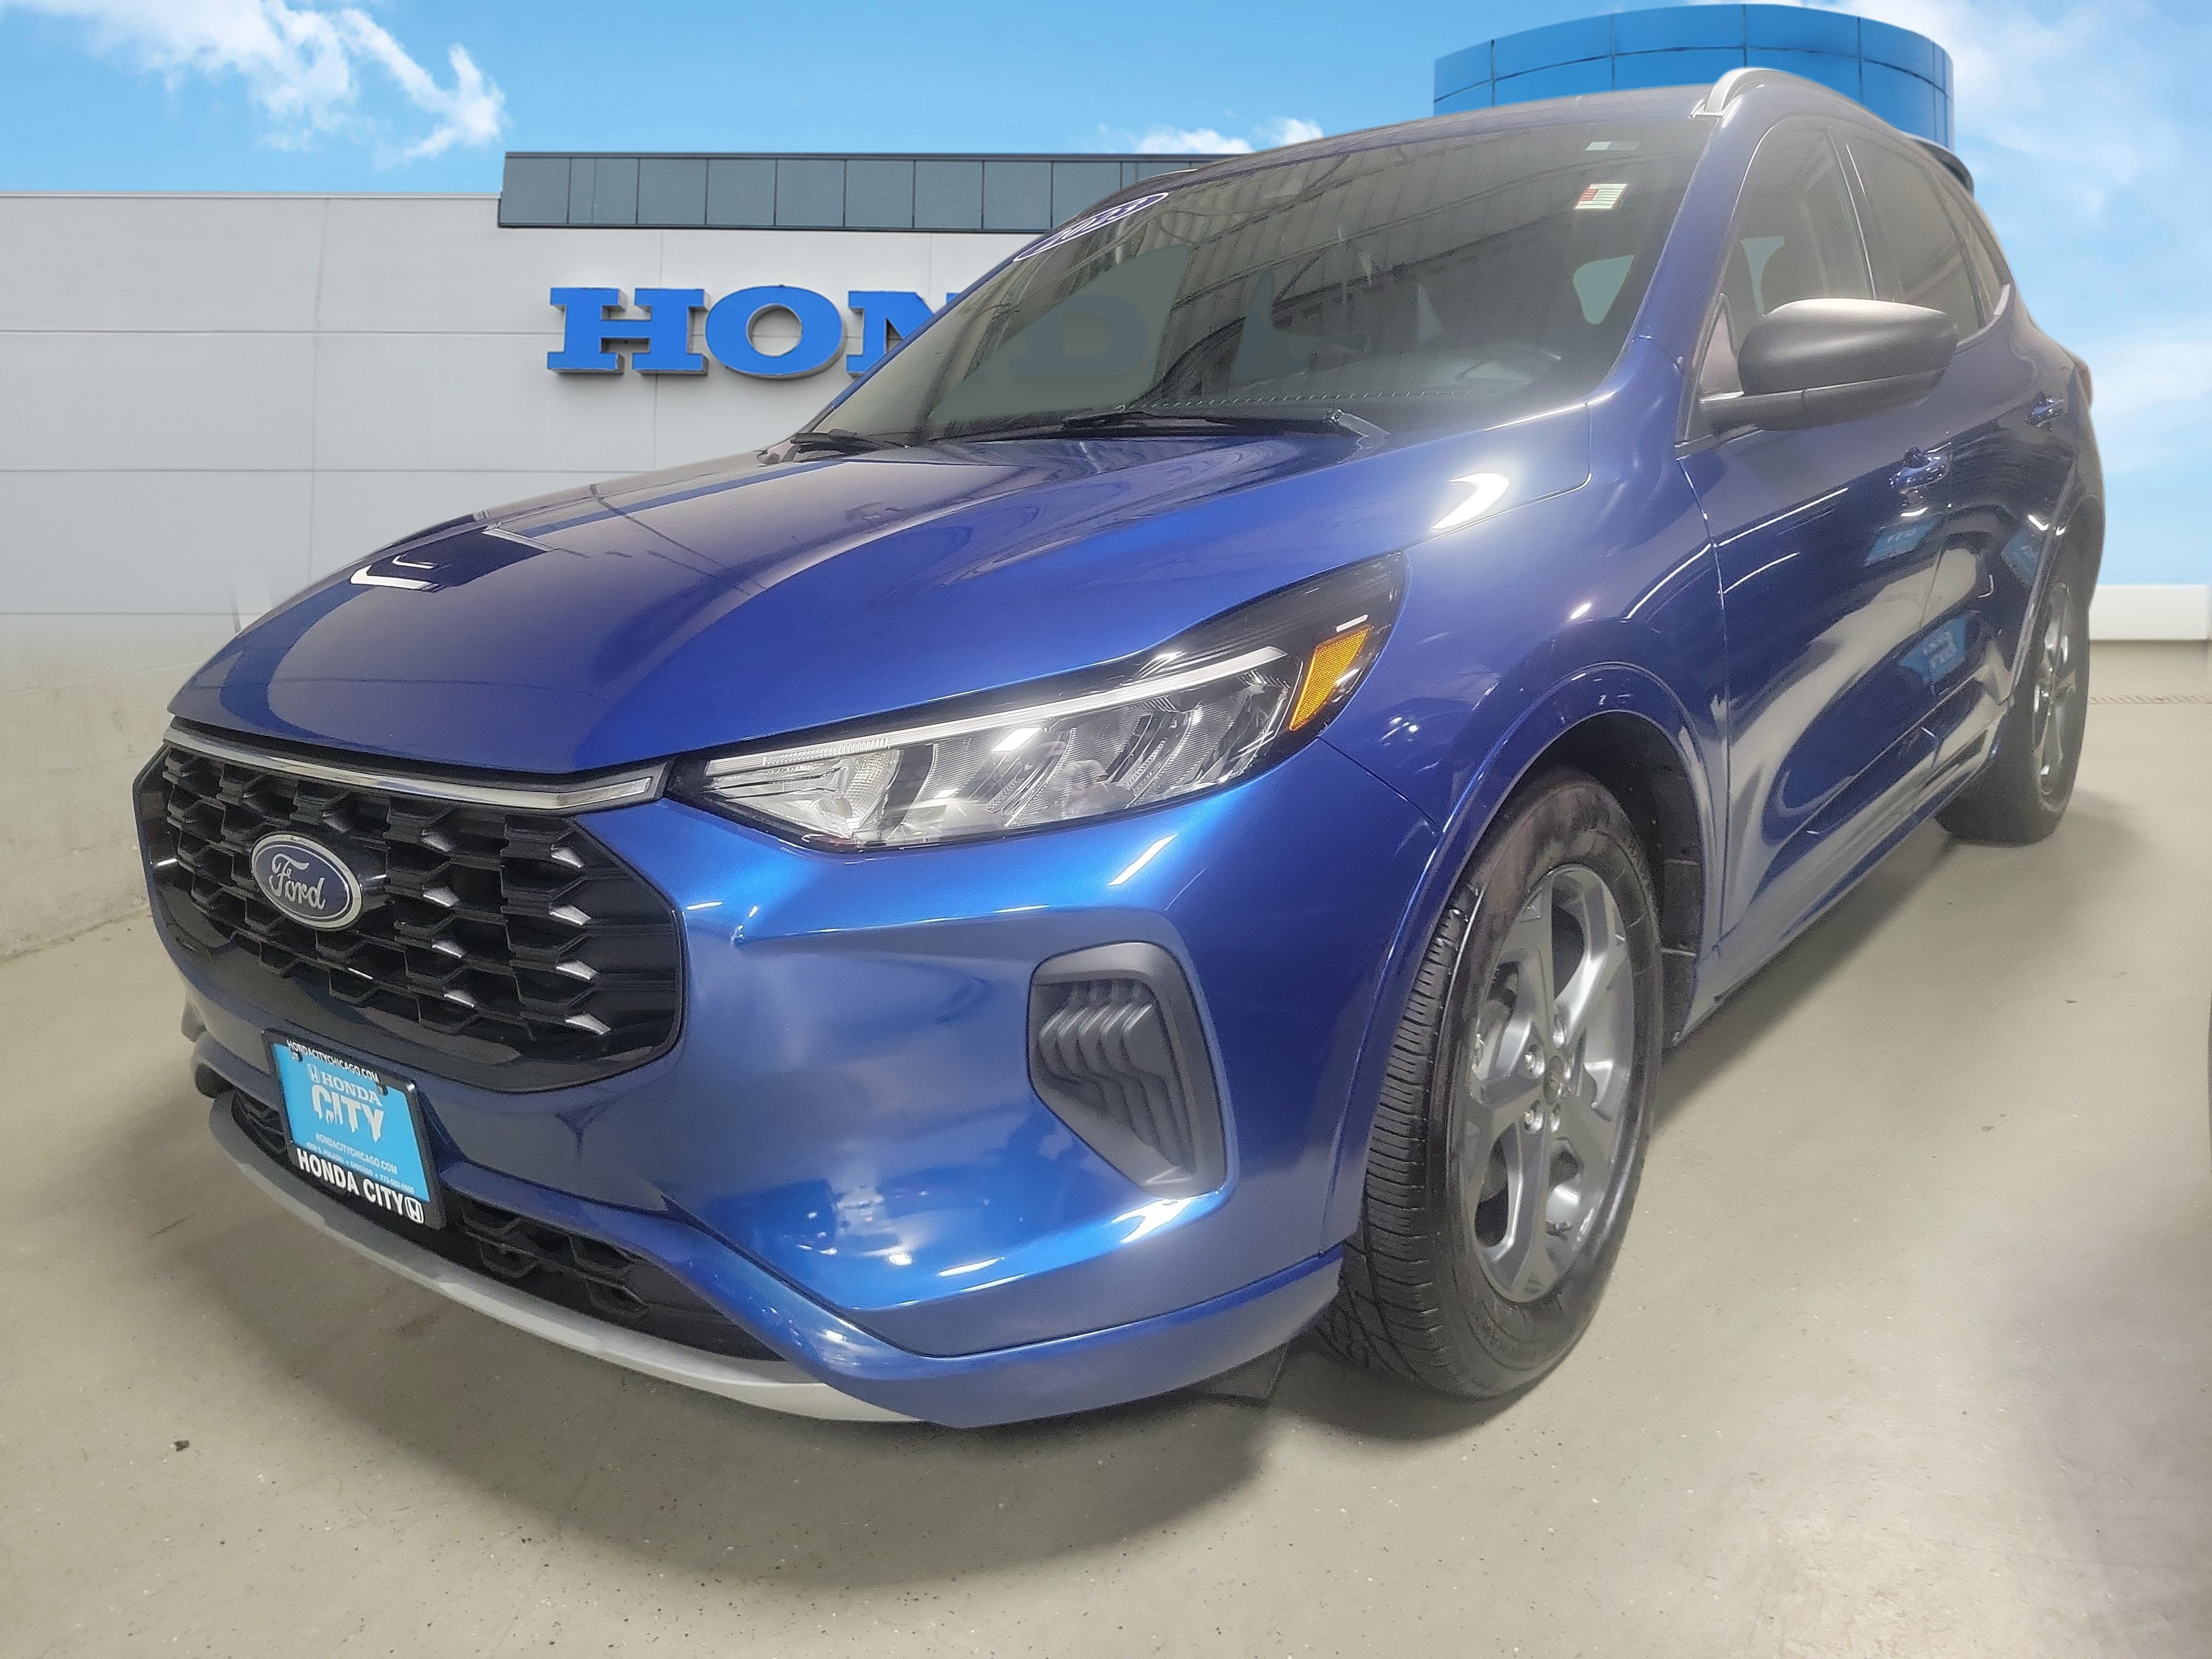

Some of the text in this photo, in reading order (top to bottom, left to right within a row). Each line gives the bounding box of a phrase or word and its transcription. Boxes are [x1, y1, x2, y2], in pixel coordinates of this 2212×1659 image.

[1034, 198, 1148, 253] 2023
[269, 853, 326, 910] Ford
[286, 1039, 380, 1084] HONDACITYCHICAGO.COM
[320, 1070, 383, 1107] HONDA
[312, 1084, 384, 1143] CITY
[315, 1132, 398, 1175] HONDACITYCHICAGO.COM
[296, 1147, 360, 1196] HONDA
[363, 1178, 403, 1216] CITY
